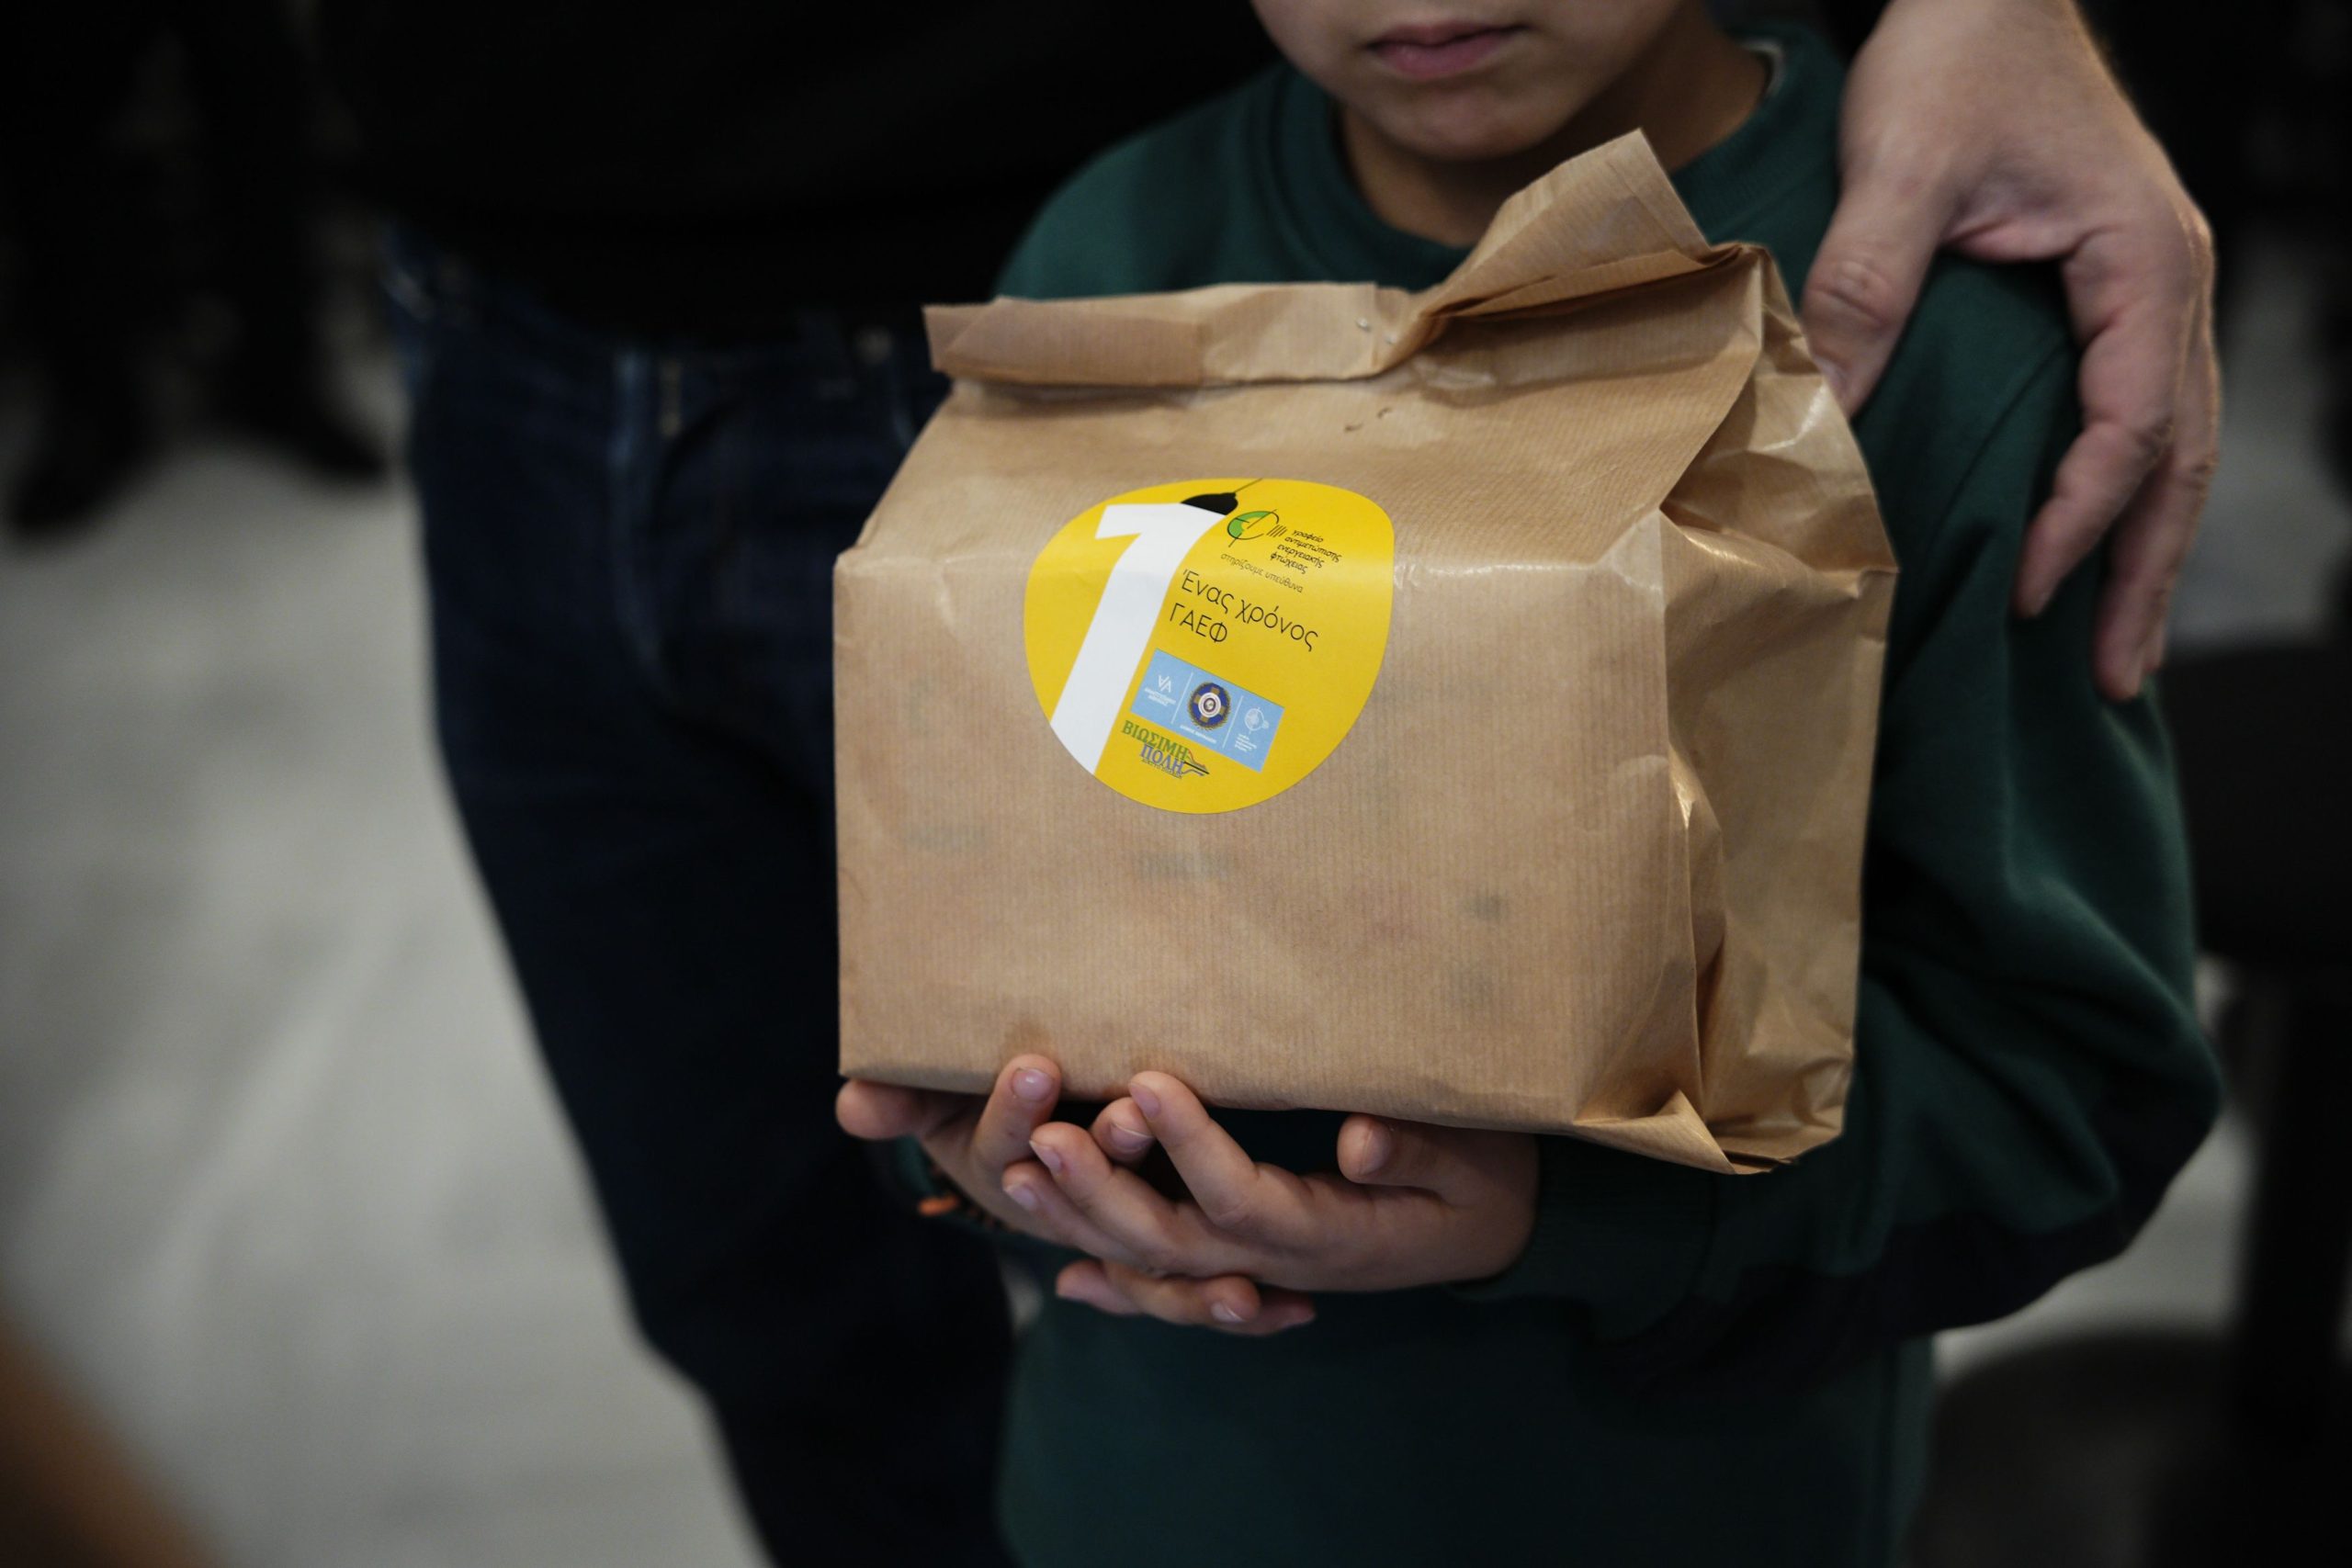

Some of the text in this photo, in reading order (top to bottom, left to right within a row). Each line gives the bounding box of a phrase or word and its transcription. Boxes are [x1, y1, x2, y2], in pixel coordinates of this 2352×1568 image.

[1169, 603, 1228, 643] ΓΑΕΦ
[1182, 569, 1318, 652] Ένας χρόνος
[1122, 719, 1189, 761] ΒΙΩΣΙΜΗ
[1139, 743, 1184, 774] ΠΟΛΗ
